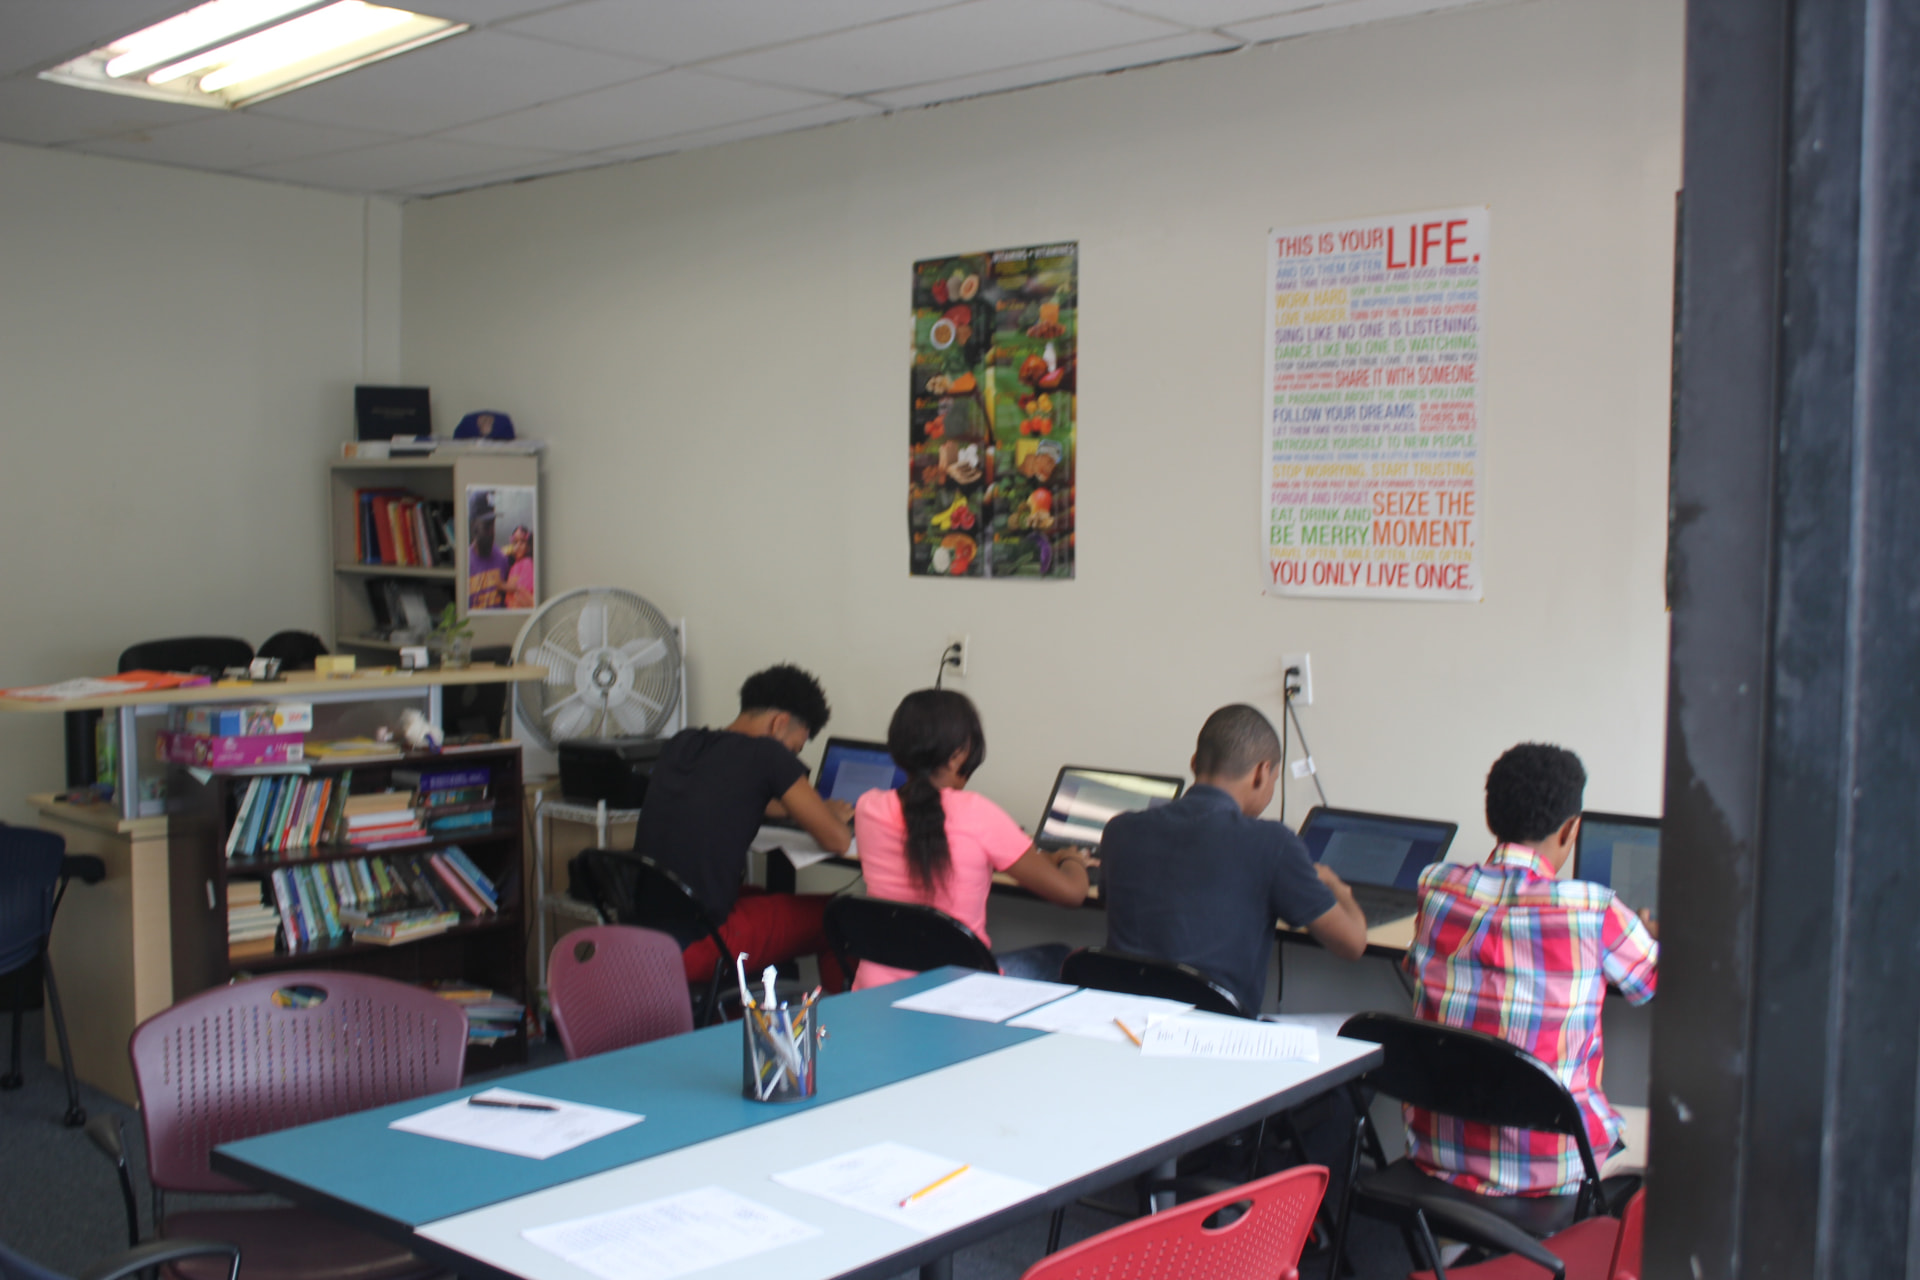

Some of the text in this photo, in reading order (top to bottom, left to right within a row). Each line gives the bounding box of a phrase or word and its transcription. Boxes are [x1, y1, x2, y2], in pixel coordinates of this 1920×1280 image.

[1276, 233, 1314, 258] THIS
[1318, 231, 1335, 255] IS
[1338, 227, 1384, 253] YOUR
[1386, 218, 1480, 271] LIFE.
[1275, 291, 1310, 310] WORK
[1275, 309, 1300, 328] LOVE
[1275, 313, 1480, 345] SING LIKE NO ONE IS LISTENING.
[1275, 331, 1478, 361] DANCE LIKE NO ONE IS WATCHING.
[1335, 360, 1480, 390] SHARE IT WITH SOMEONE.
[1273, 401, 1417, 423] FOLLOW YOUR DREAMS.
[1273, 438, 1328, 452] INTRODUCE
[1331, 436, 1383, 450] YOURSELF
[1386, 435, 1402, 449] TO
[1404, 434, 1431, 449] NEW
[1273, 463, 1303, 479] STOP
[1371, 462, 1410, 478] START
[1272, 490, 1309, 506] FORGIVE
[1311, 490, 1331, 505] AND
[1372, 489, 1476, 517] SEIZE THE
[1272, 506, 1373, 525] EAT, DRINK AND
[1271, 524, 1296, 546] BE
[1372, 519, 1476, 548] MOMENT.
[1270, 559, 1475, 592] YOU ONLY LIVE ONCE.
